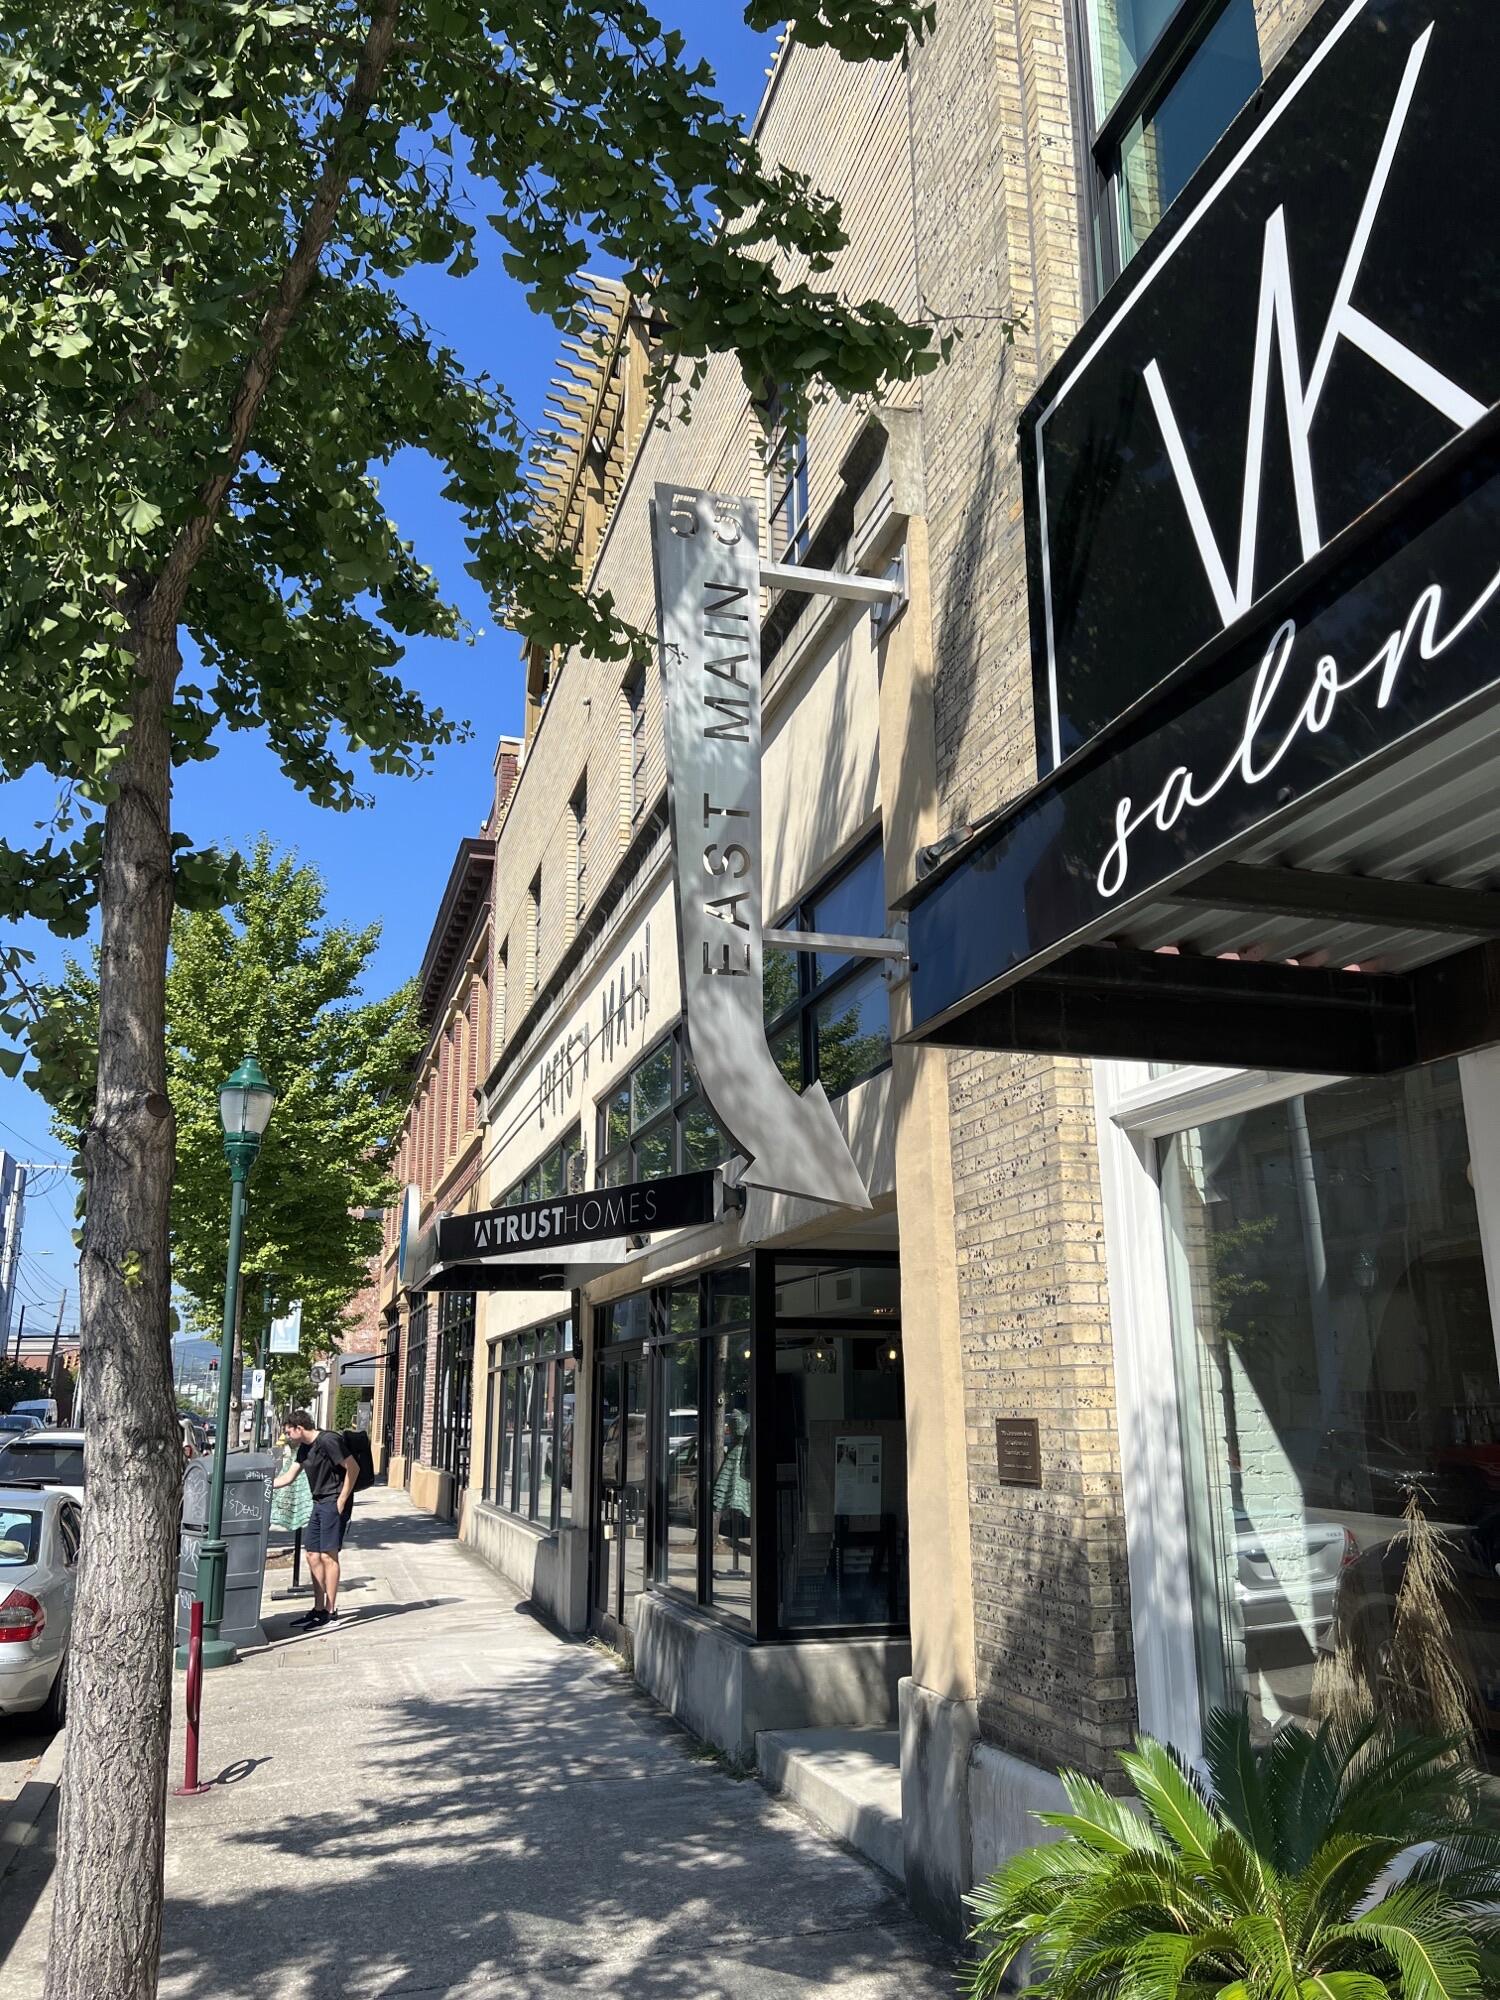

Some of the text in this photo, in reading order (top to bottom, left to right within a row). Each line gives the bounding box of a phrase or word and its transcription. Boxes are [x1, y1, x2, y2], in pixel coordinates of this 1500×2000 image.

[669, 493, 743, 546] 55
[702, 581, 752, 979] EAST MAIN
[1096, 561, 1500, 900] salon
[539, 1033, 573, 1131] LOFTS
[602, 921, 651, 1064] MAIN
